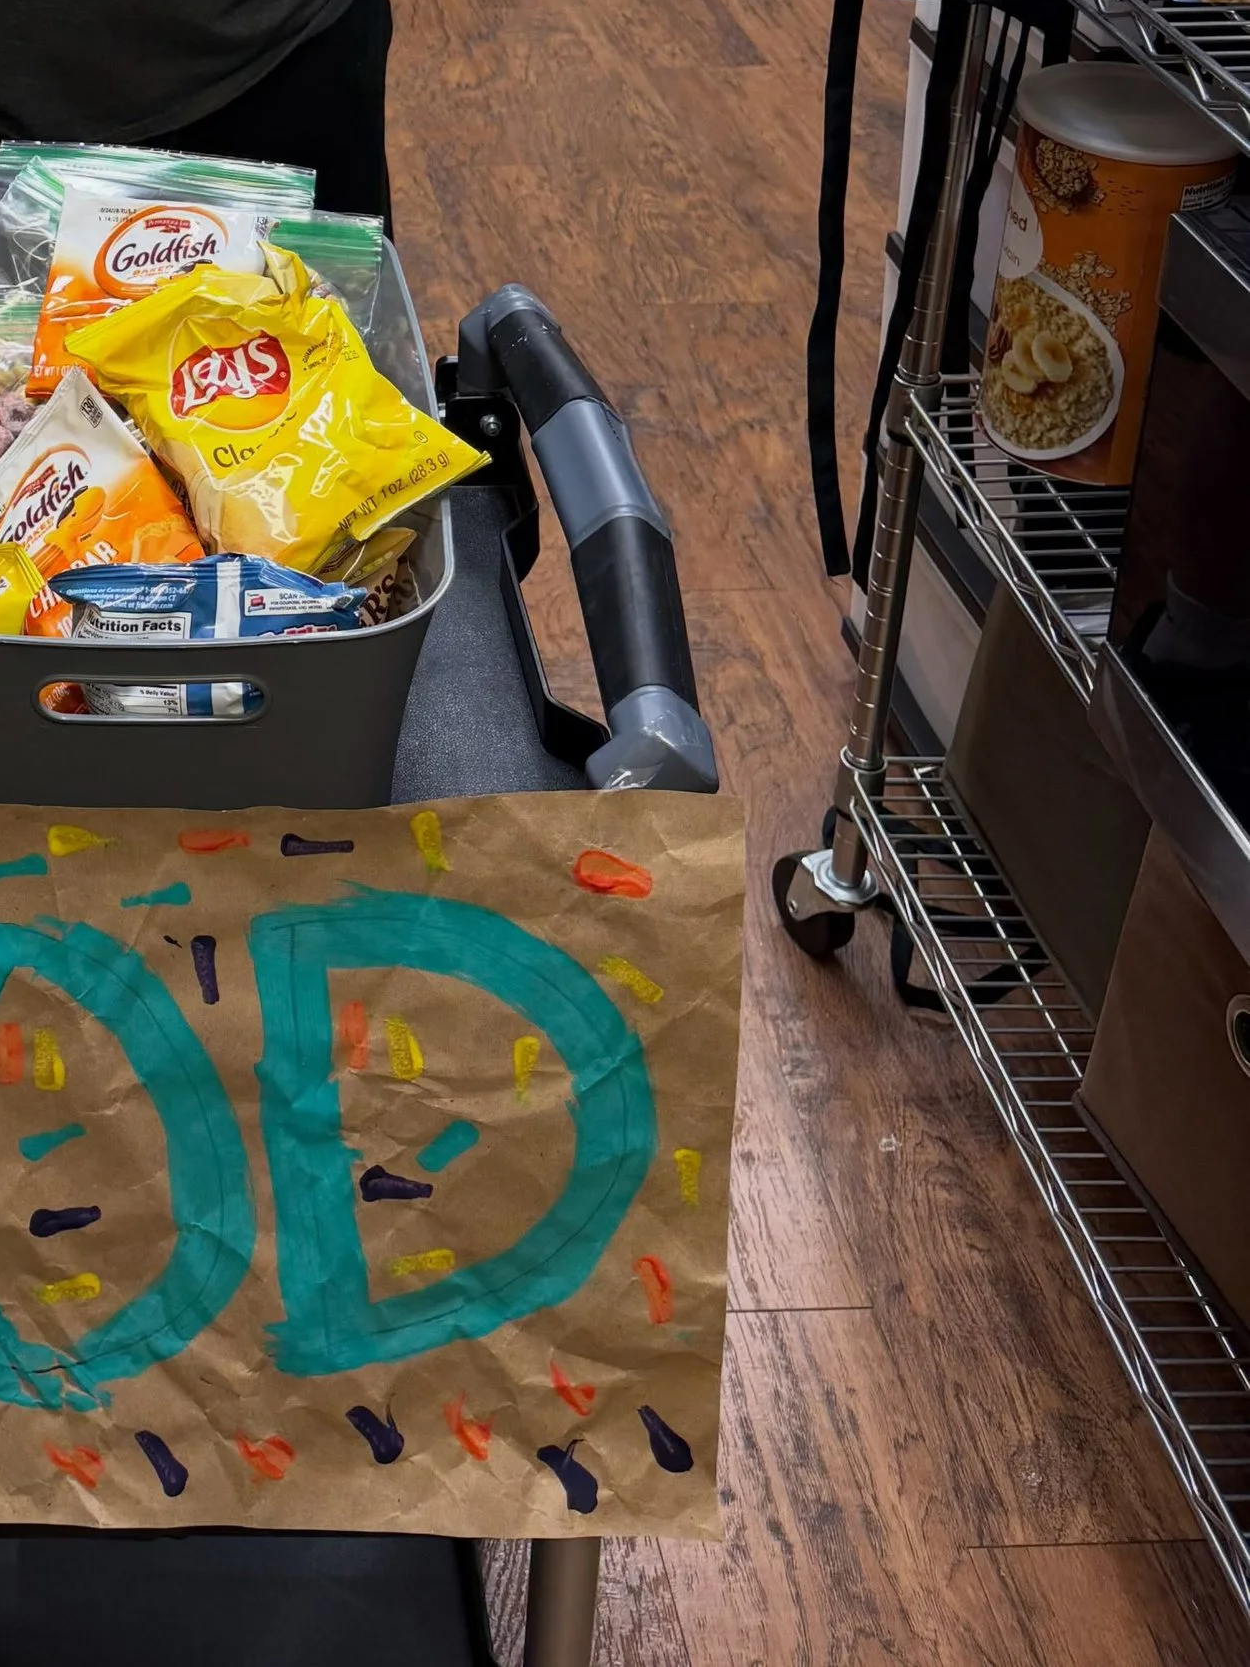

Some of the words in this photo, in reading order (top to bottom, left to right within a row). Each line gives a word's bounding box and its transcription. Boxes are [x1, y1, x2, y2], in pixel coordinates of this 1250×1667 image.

[112, 233, 218, 273] Goldfish
[81, 396, 95, 415] 130
[338, 509, 357, 531] NET
[387, 478, 410, 496] OZ.
[409, 457, 438, 485] (28.3
[437, 450, 451, 468] g)
[279, 592, 298, 600] SCAN
[88, 610, 139, 633] Nutrition
[142, 619, 182, 633] Facts
